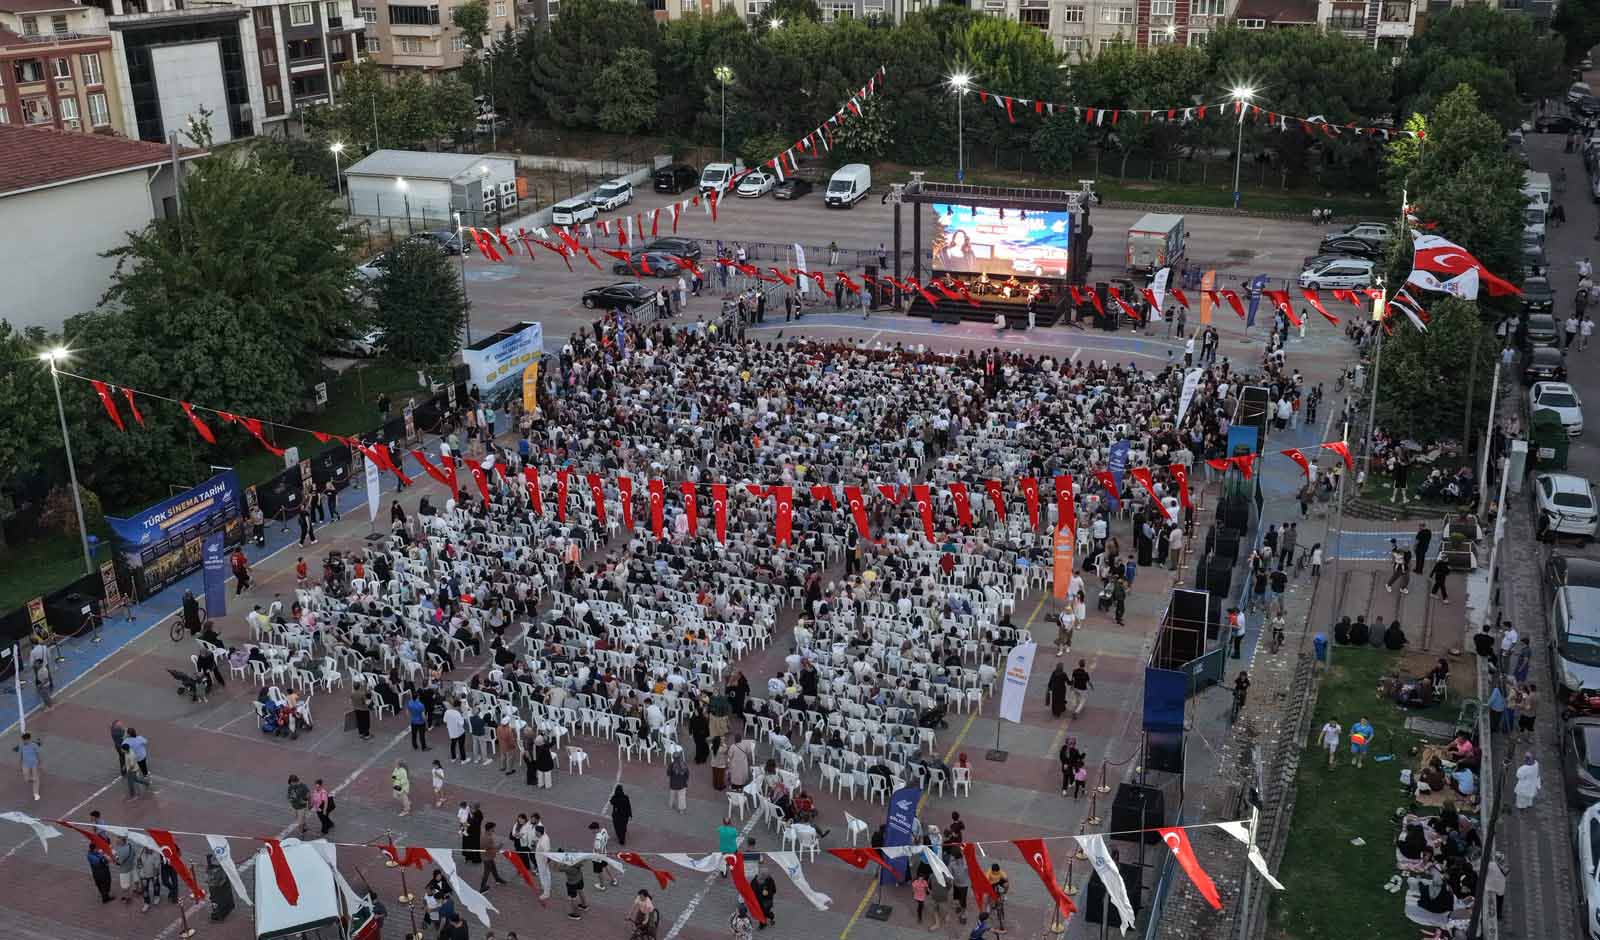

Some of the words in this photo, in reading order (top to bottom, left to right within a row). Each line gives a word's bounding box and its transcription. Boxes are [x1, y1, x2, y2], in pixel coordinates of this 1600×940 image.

[143, 512, 167, 528] TÜRK
[167, 496, 199, 516] SİNEMA
[200, 481, 225, 500] TARİHİ
